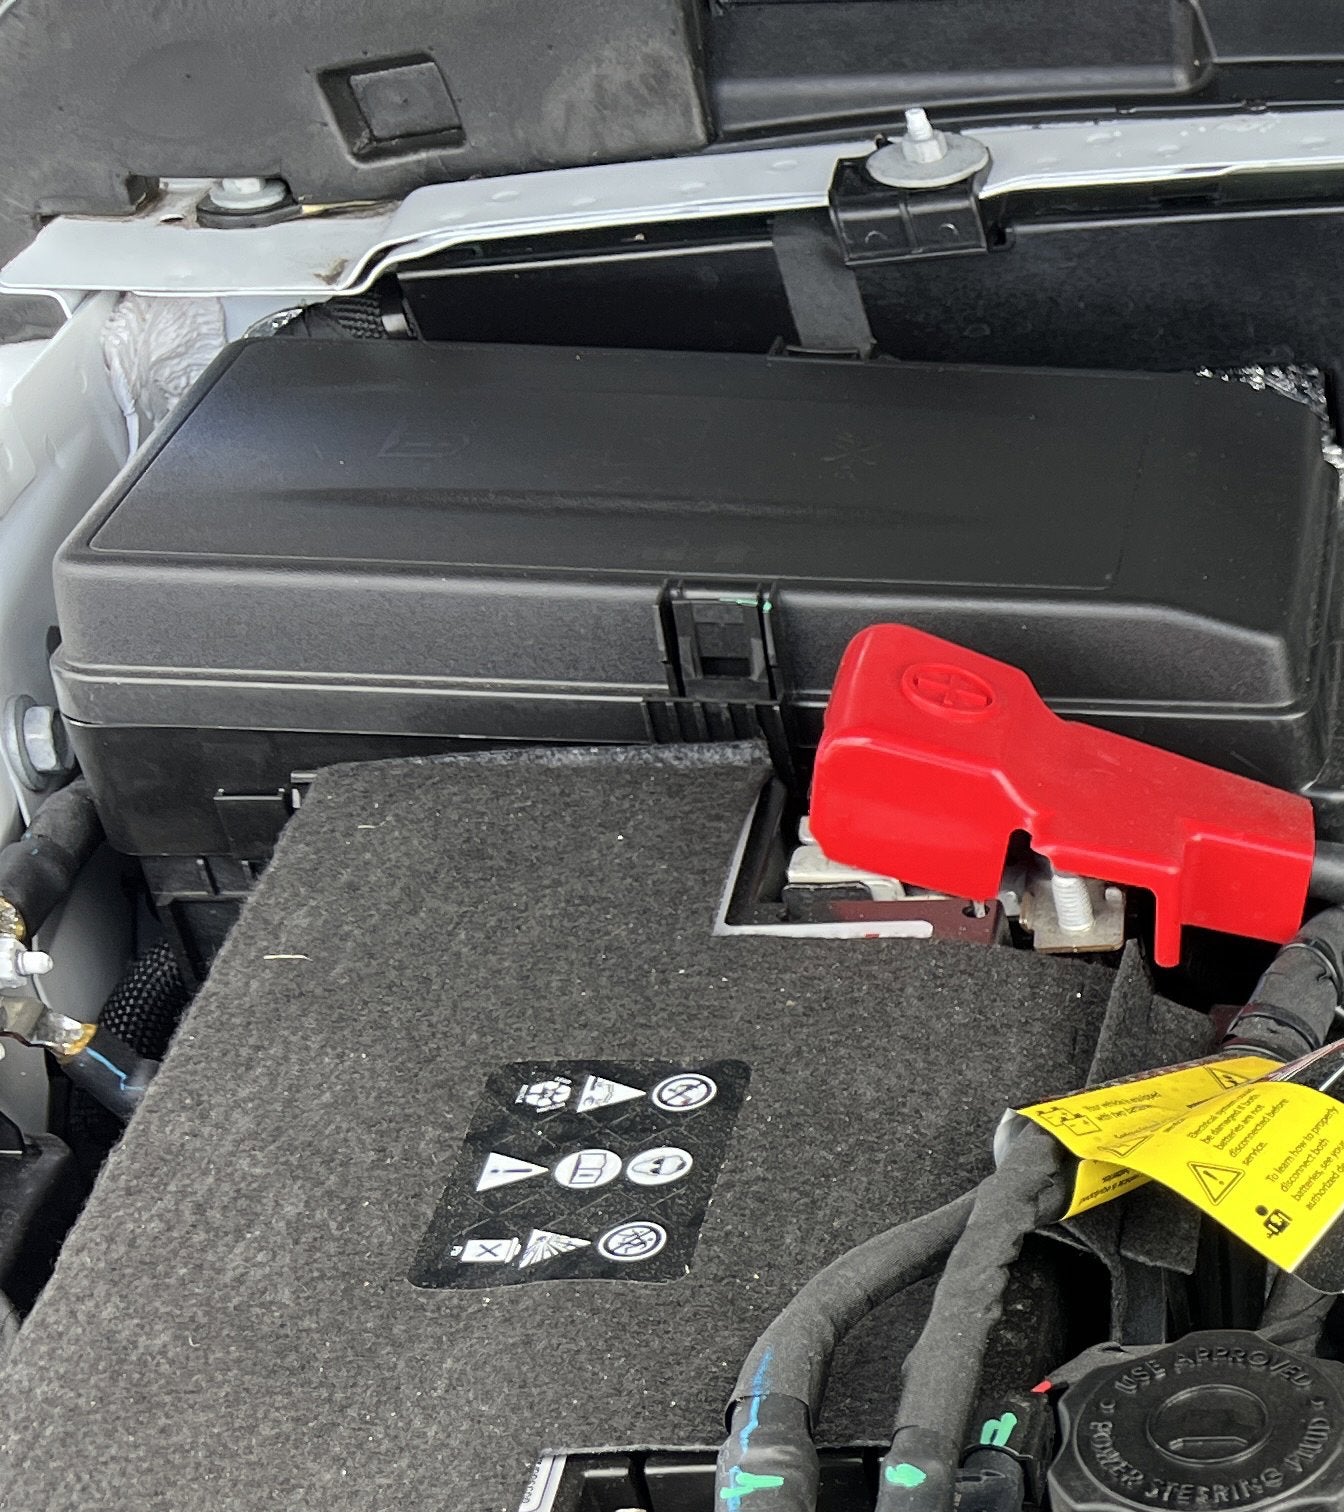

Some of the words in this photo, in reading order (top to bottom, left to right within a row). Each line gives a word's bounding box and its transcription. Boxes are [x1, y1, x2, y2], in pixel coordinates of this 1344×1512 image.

[1200, 1134, 1215, 1145] be
[1210, 1109, 1242, 1136] damaged
[1213, 1123, 1245, 1151] batteries
[1241, 1113, 1254, 1124] are
[1251, 1103, 1265, 1115] not
[1229, 1116, 1270, 1158] disconnected
[1265, 1099, 1289, 1118] before
[1265, 1173, 1279, 1183] To
[1272, 1156, 1295, 1174] learn
[1289, 1141, 1307, 1157] how
[1303, 1132, 1314, 1142] to
[1311, 1106, 1339, 1135] properly
[1242, 1142, 1268, 1166] service.
[1280, 1153, 1316, 1193] disconnect
[1309, 1138, 1330, 1156] both
[1290, 1169, 1325, 1202] batteries,
[1320, 1156, 1334, 1170] see
[1305, 1170, 1341, 1211] authorized
[1115, 1359, 1167, 1395] USE
[1173, 1346, 1313, 1391] APPROVED
[1089, 1420, 1145, 1487] POWER
[1144, 1467, 1284, 1505] STEERING
[1284, 1417, 1330, 1473] FLUID
